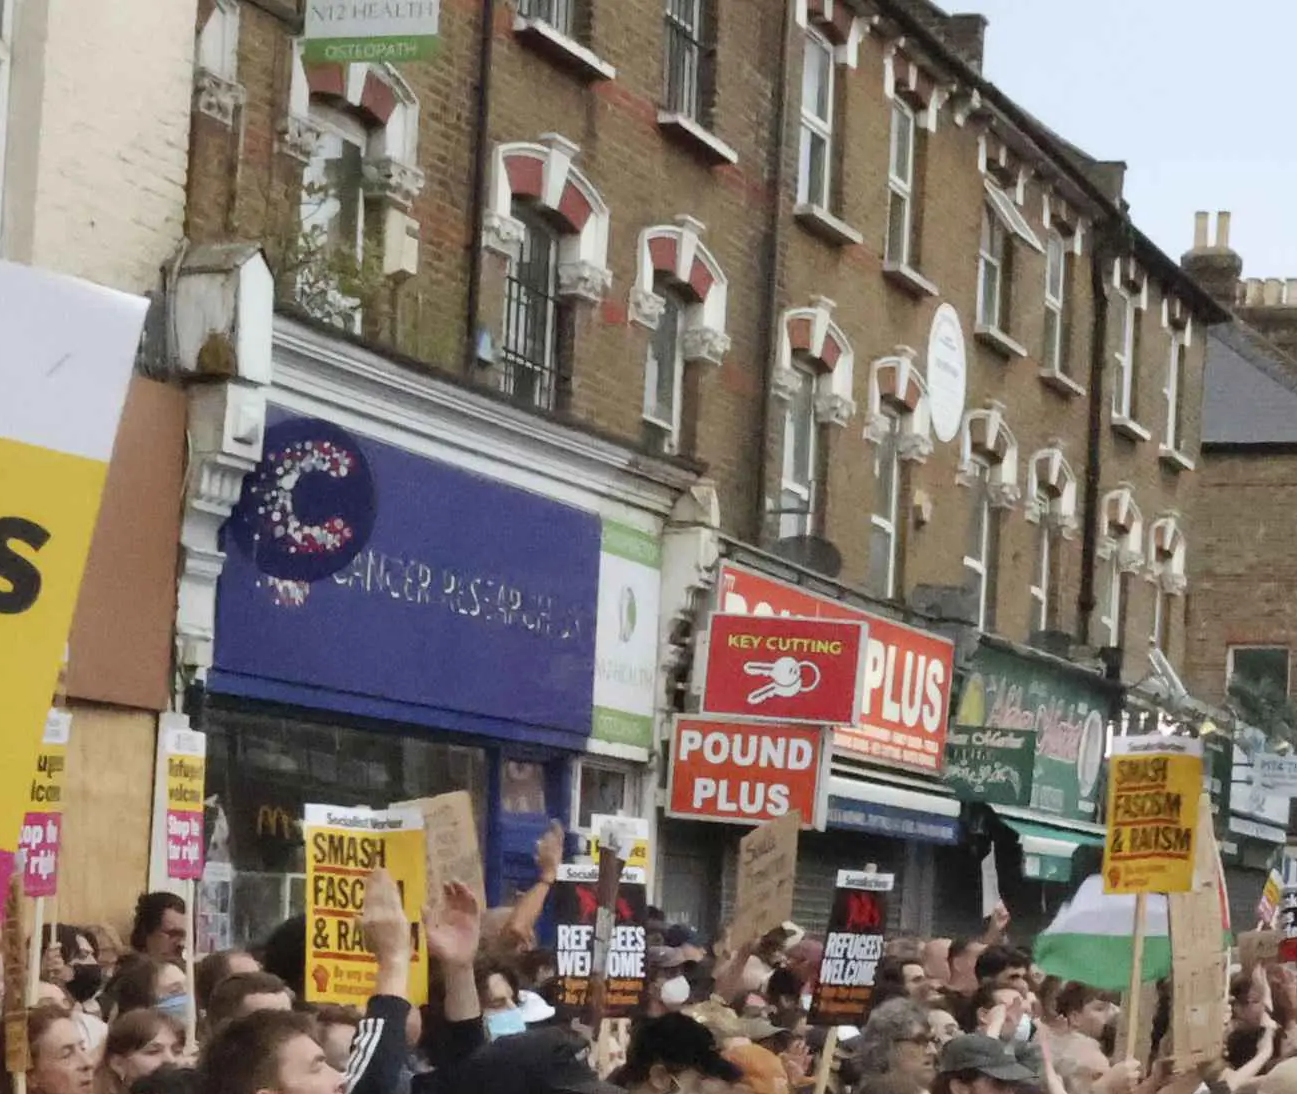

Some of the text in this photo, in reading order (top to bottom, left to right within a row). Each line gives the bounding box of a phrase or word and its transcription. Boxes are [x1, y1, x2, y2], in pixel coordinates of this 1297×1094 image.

[353, 0, 433, 20] HEALTH
[727, 633, 842, 656] KEY CUTTING
[860, 637, 946, 733] PLUS
[678, 728, 814, 771] POUND
[692, 777, 791, 818] PLUS
[312, 831, 386, 869] SMASH
[825, 932, 884, 960] REFUGEES
[820, 958, 878, 986] WELCOME
